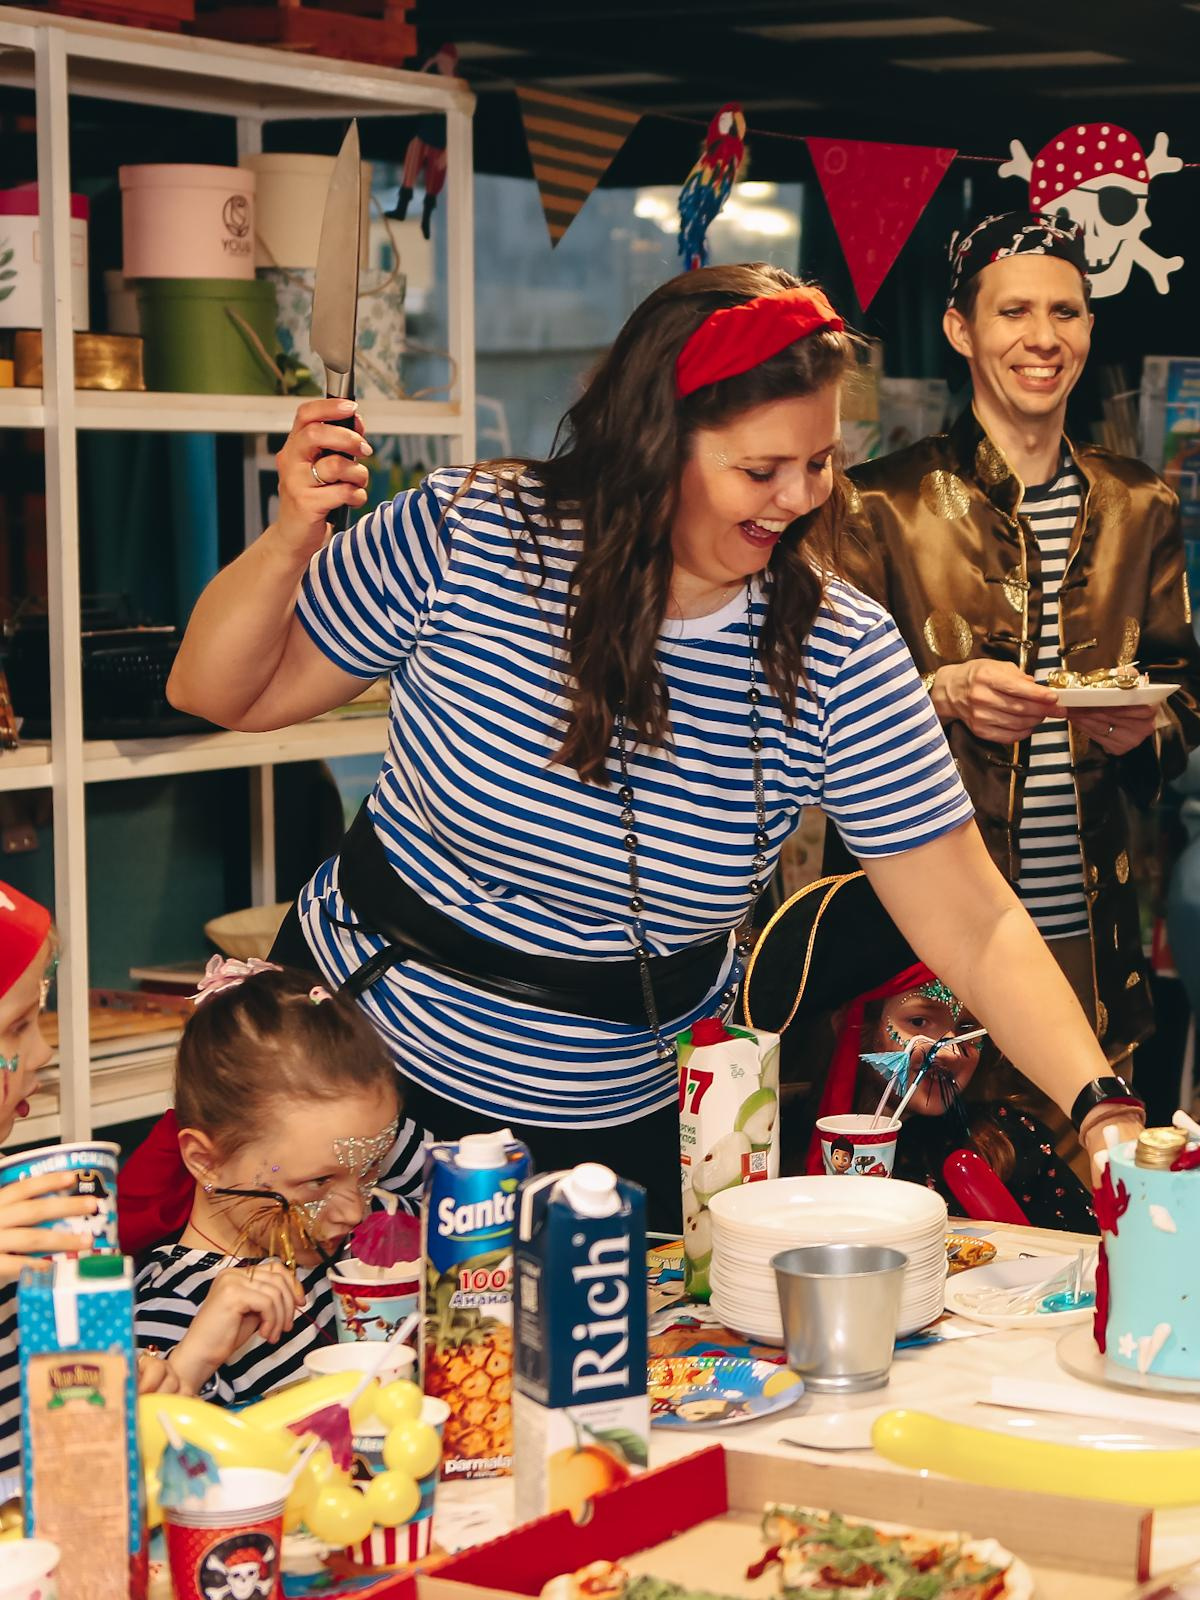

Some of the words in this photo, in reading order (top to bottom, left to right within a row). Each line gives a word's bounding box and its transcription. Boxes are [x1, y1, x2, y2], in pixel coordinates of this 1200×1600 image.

[460, 1268, 513, 1292] 100
[452, 1291, 512, 1306] Анана
[571, 1233, 630, 1395] Rich
